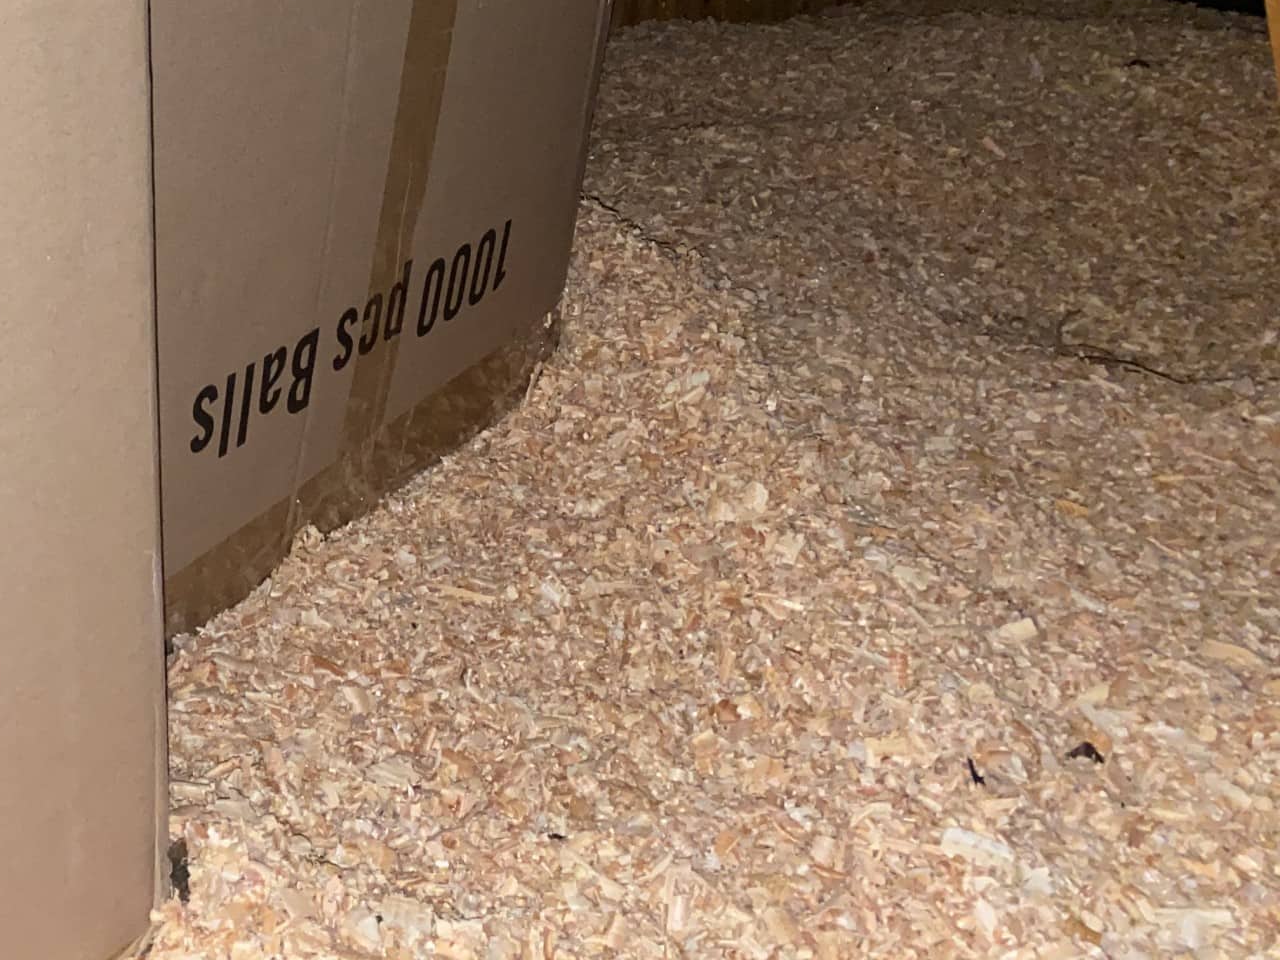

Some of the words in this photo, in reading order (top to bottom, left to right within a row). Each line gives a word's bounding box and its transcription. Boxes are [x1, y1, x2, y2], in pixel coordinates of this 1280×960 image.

[332, 259, 413, 372] pcs
[417, 219, 512, 338] 1000
[189, 327, 320, 458] Balls
